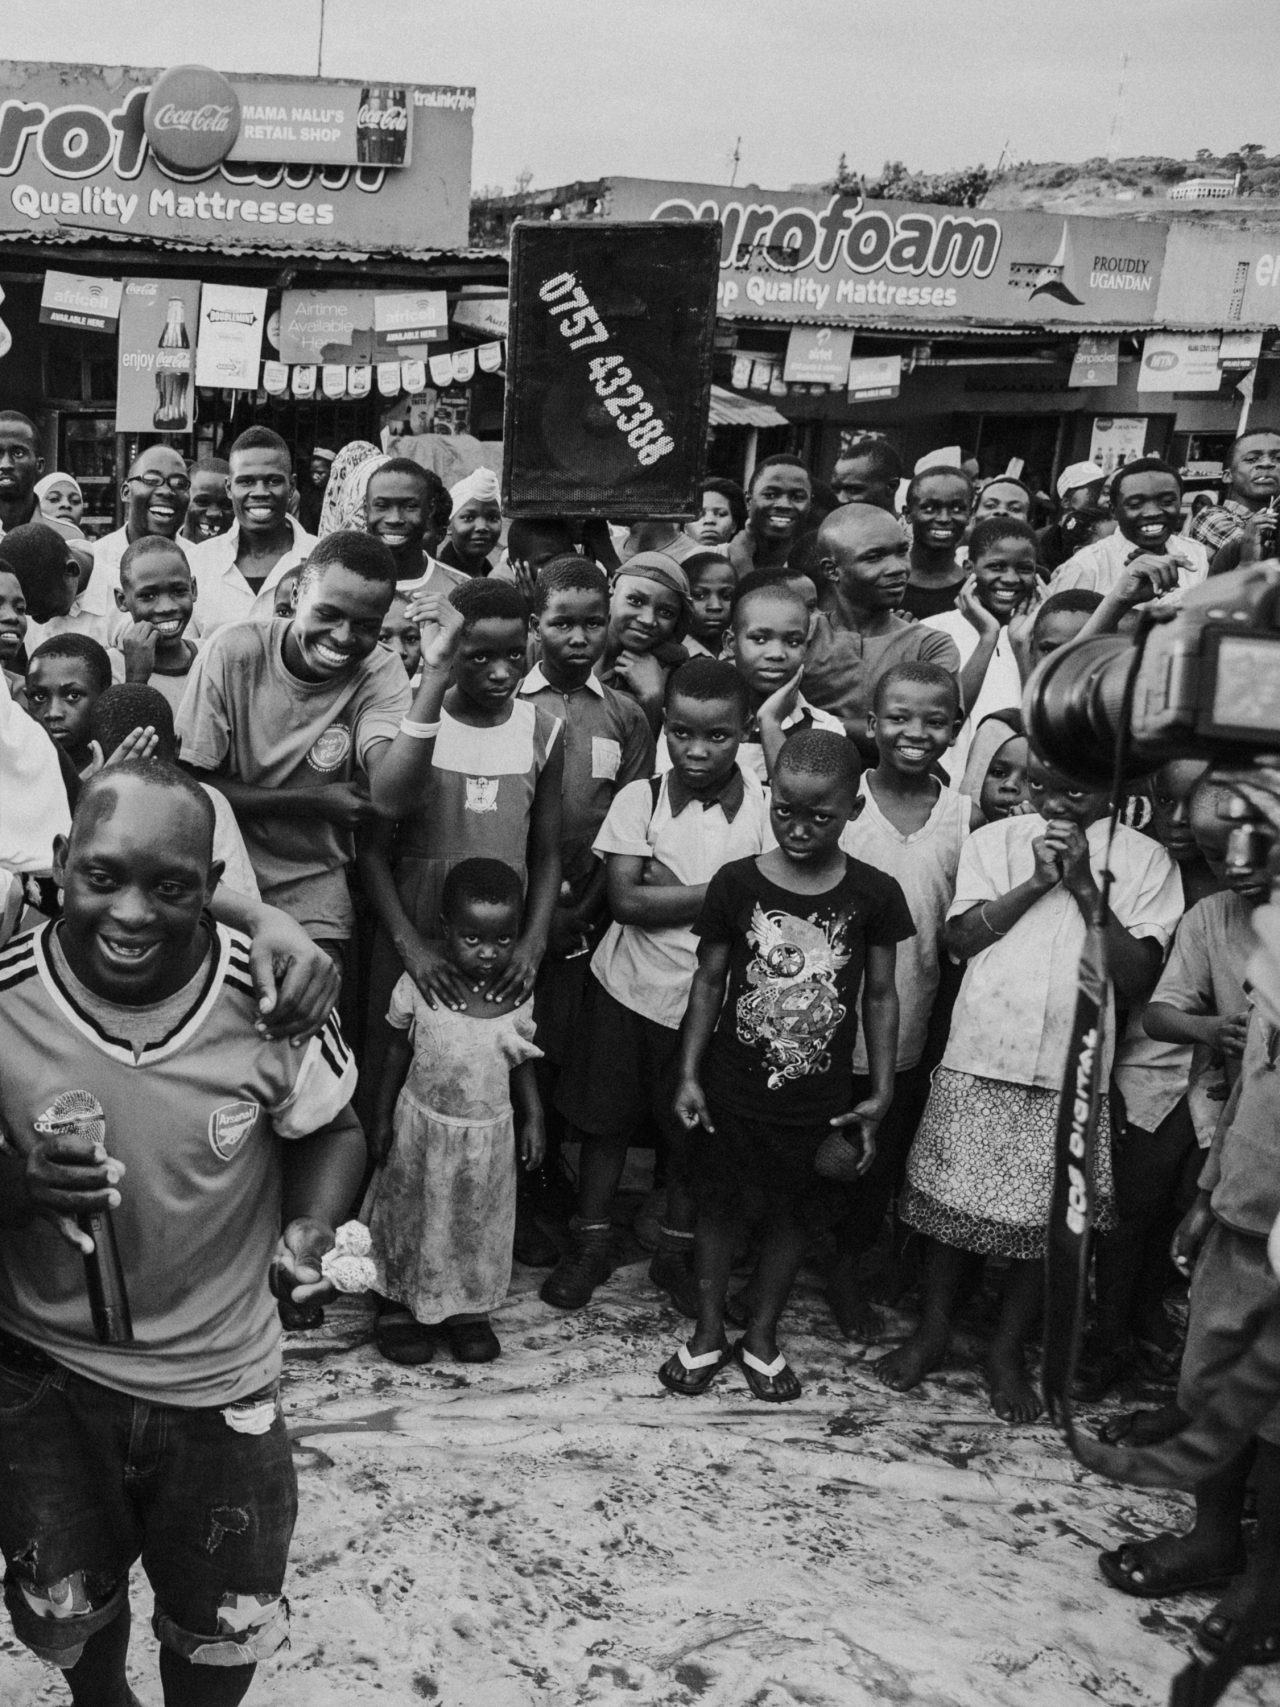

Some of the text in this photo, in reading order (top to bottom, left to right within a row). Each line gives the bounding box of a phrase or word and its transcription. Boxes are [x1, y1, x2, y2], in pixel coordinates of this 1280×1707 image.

[242, 105, 345, 124] MAMA NALU'S
[244, 125, 341, 142] RETAIL SHOP
[12, 184, 138, 225] Quality
[148, 188, 335, 225] Mattresses
[649, 194, 1002, 279] urofoam
[1093, 256, 1150, 273] PROUDLY
[1089, 272, 1152, 291] UGANDAN
[54, 290, 109, 309] africell
[746, 275, 830, 310] Quality
[835, 278, 958, 307] Mattresses
[295, 301, 348, 317] Airtime
[50, 312, 106, 328] AVAILABLE HERE
[288, 319, 355, 333] Available
[386, 329, 438, 342] AVAILABLE HERE
[122, 350, 154, 371] enjoy
[539, 271, 675, 465] 0757 432388
[219, 1107, 253, 1125] Arsenal
